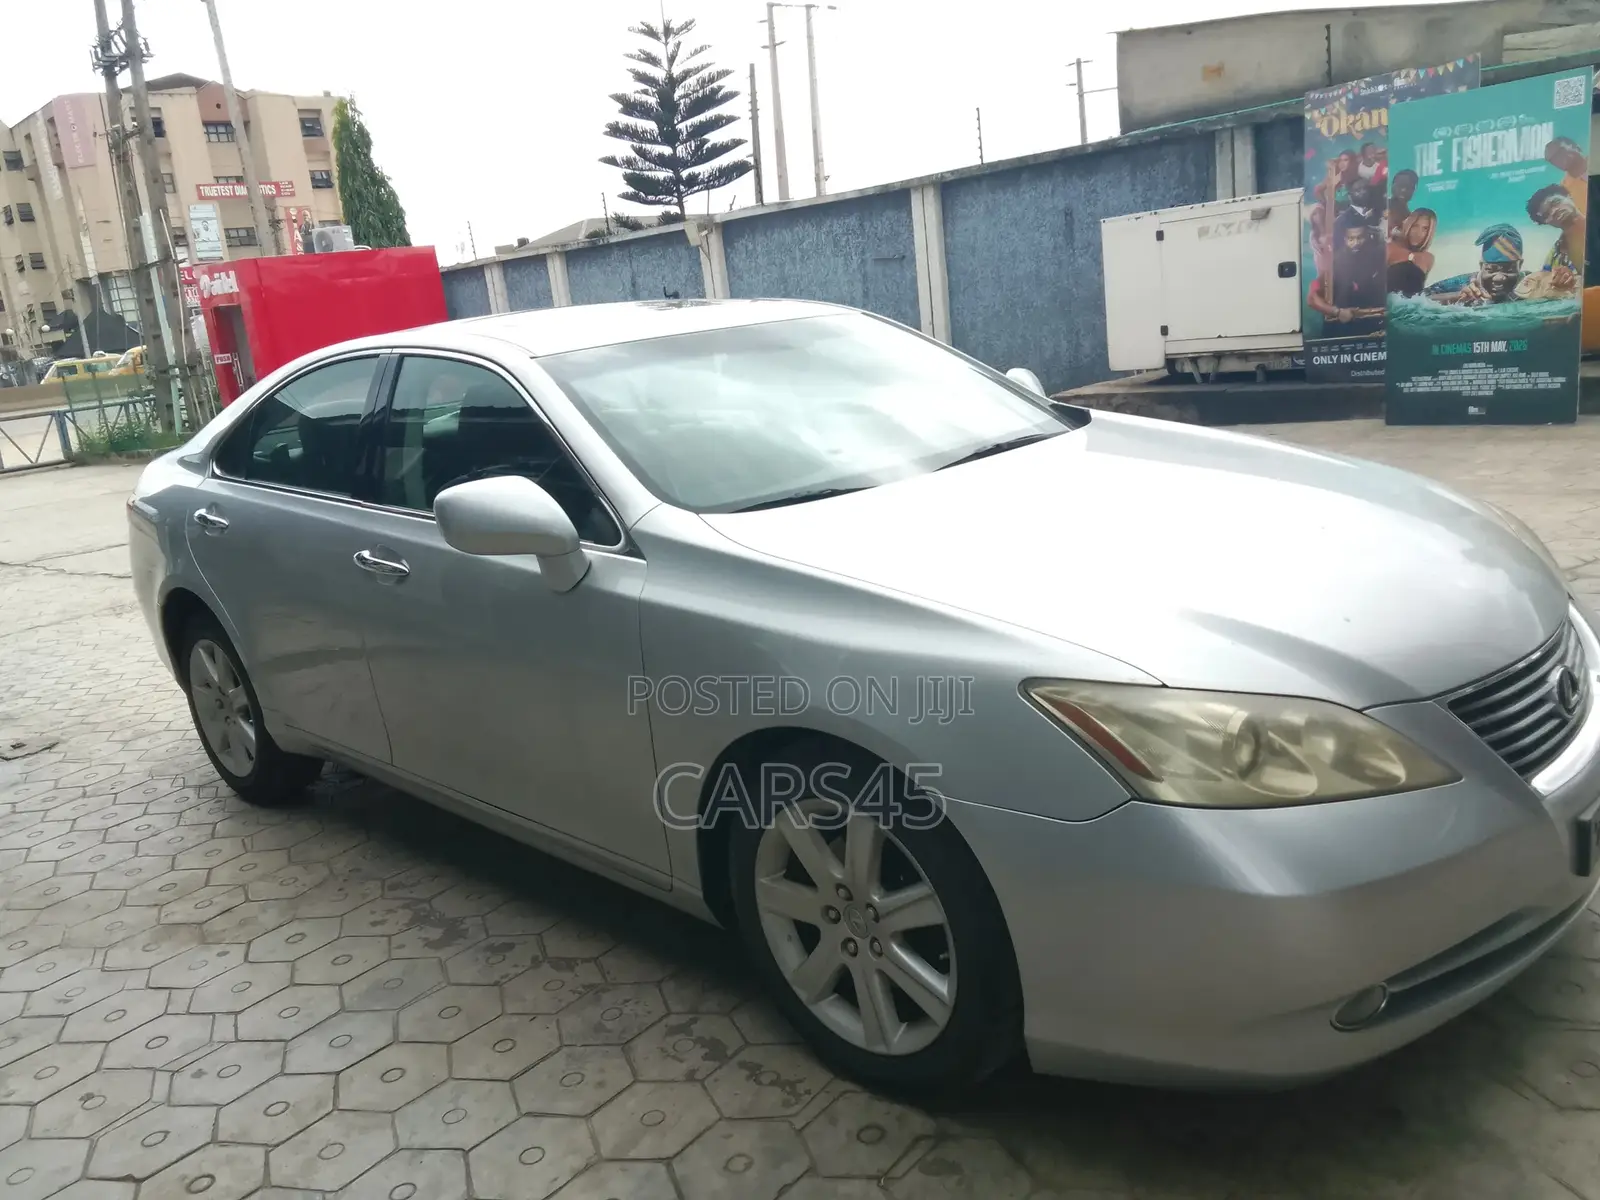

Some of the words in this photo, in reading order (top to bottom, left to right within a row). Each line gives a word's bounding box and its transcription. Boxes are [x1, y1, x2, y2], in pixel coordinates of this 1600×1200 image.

[1414, 140, 1444, 177] THE
[1452, 121, 1554, 172] FISHERMAN
[199, 185, 234, 197] TRUETEST
[1440, 342, 1472, 355] CINEMAS
[1473, 341, 1490, 353] 15TH
[1490, 340, 1508, 352] MAY,
[1313, 354, 1338, 365] ONLY
[1340, 353, 1351, 363] IN
[1353, 351, 1387, 363] CINEM
[1351, 369, 1386, 377] Distributed
